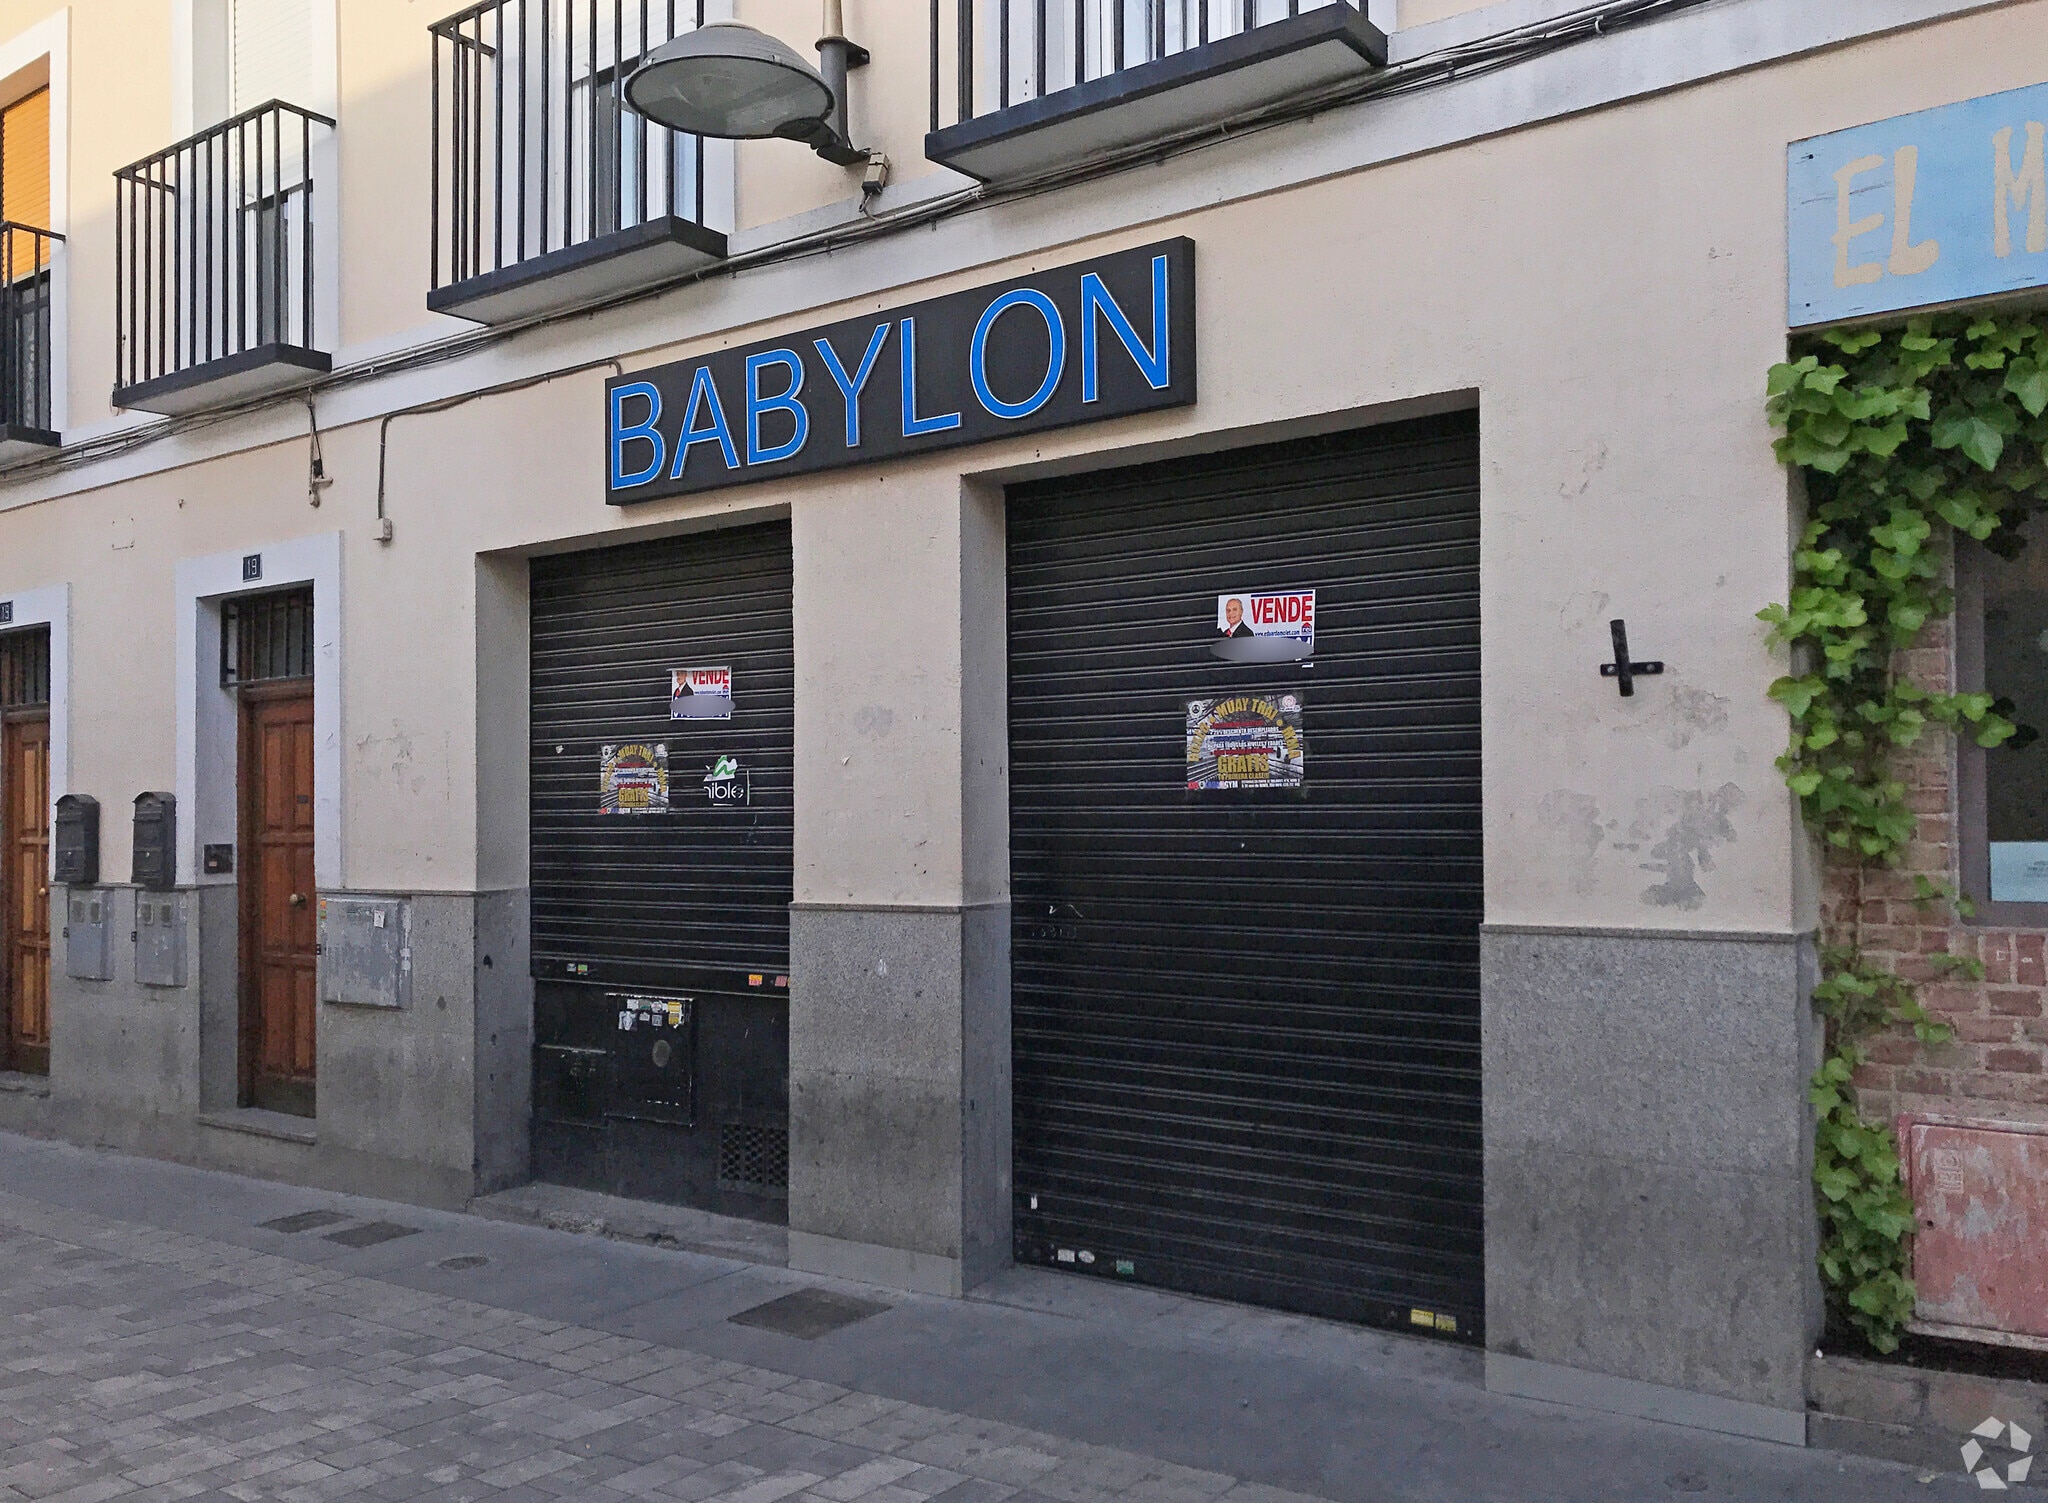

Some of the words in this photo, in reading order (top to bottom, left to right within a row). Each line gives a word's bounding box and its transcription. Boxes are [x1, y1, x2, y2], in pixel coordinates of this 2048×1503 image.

[1832, 145, 1940, 288] EL
[609, 253, 1172, 492] BABYLON
[247, 558, 258, 576] 19
[1250, 595, 1313, 624] VENDE
[692, 670, 729, 685] VENDE
[1215, 697, 1249, 718] MUAY
[1217, 754, 1269, 774] GRATIS
